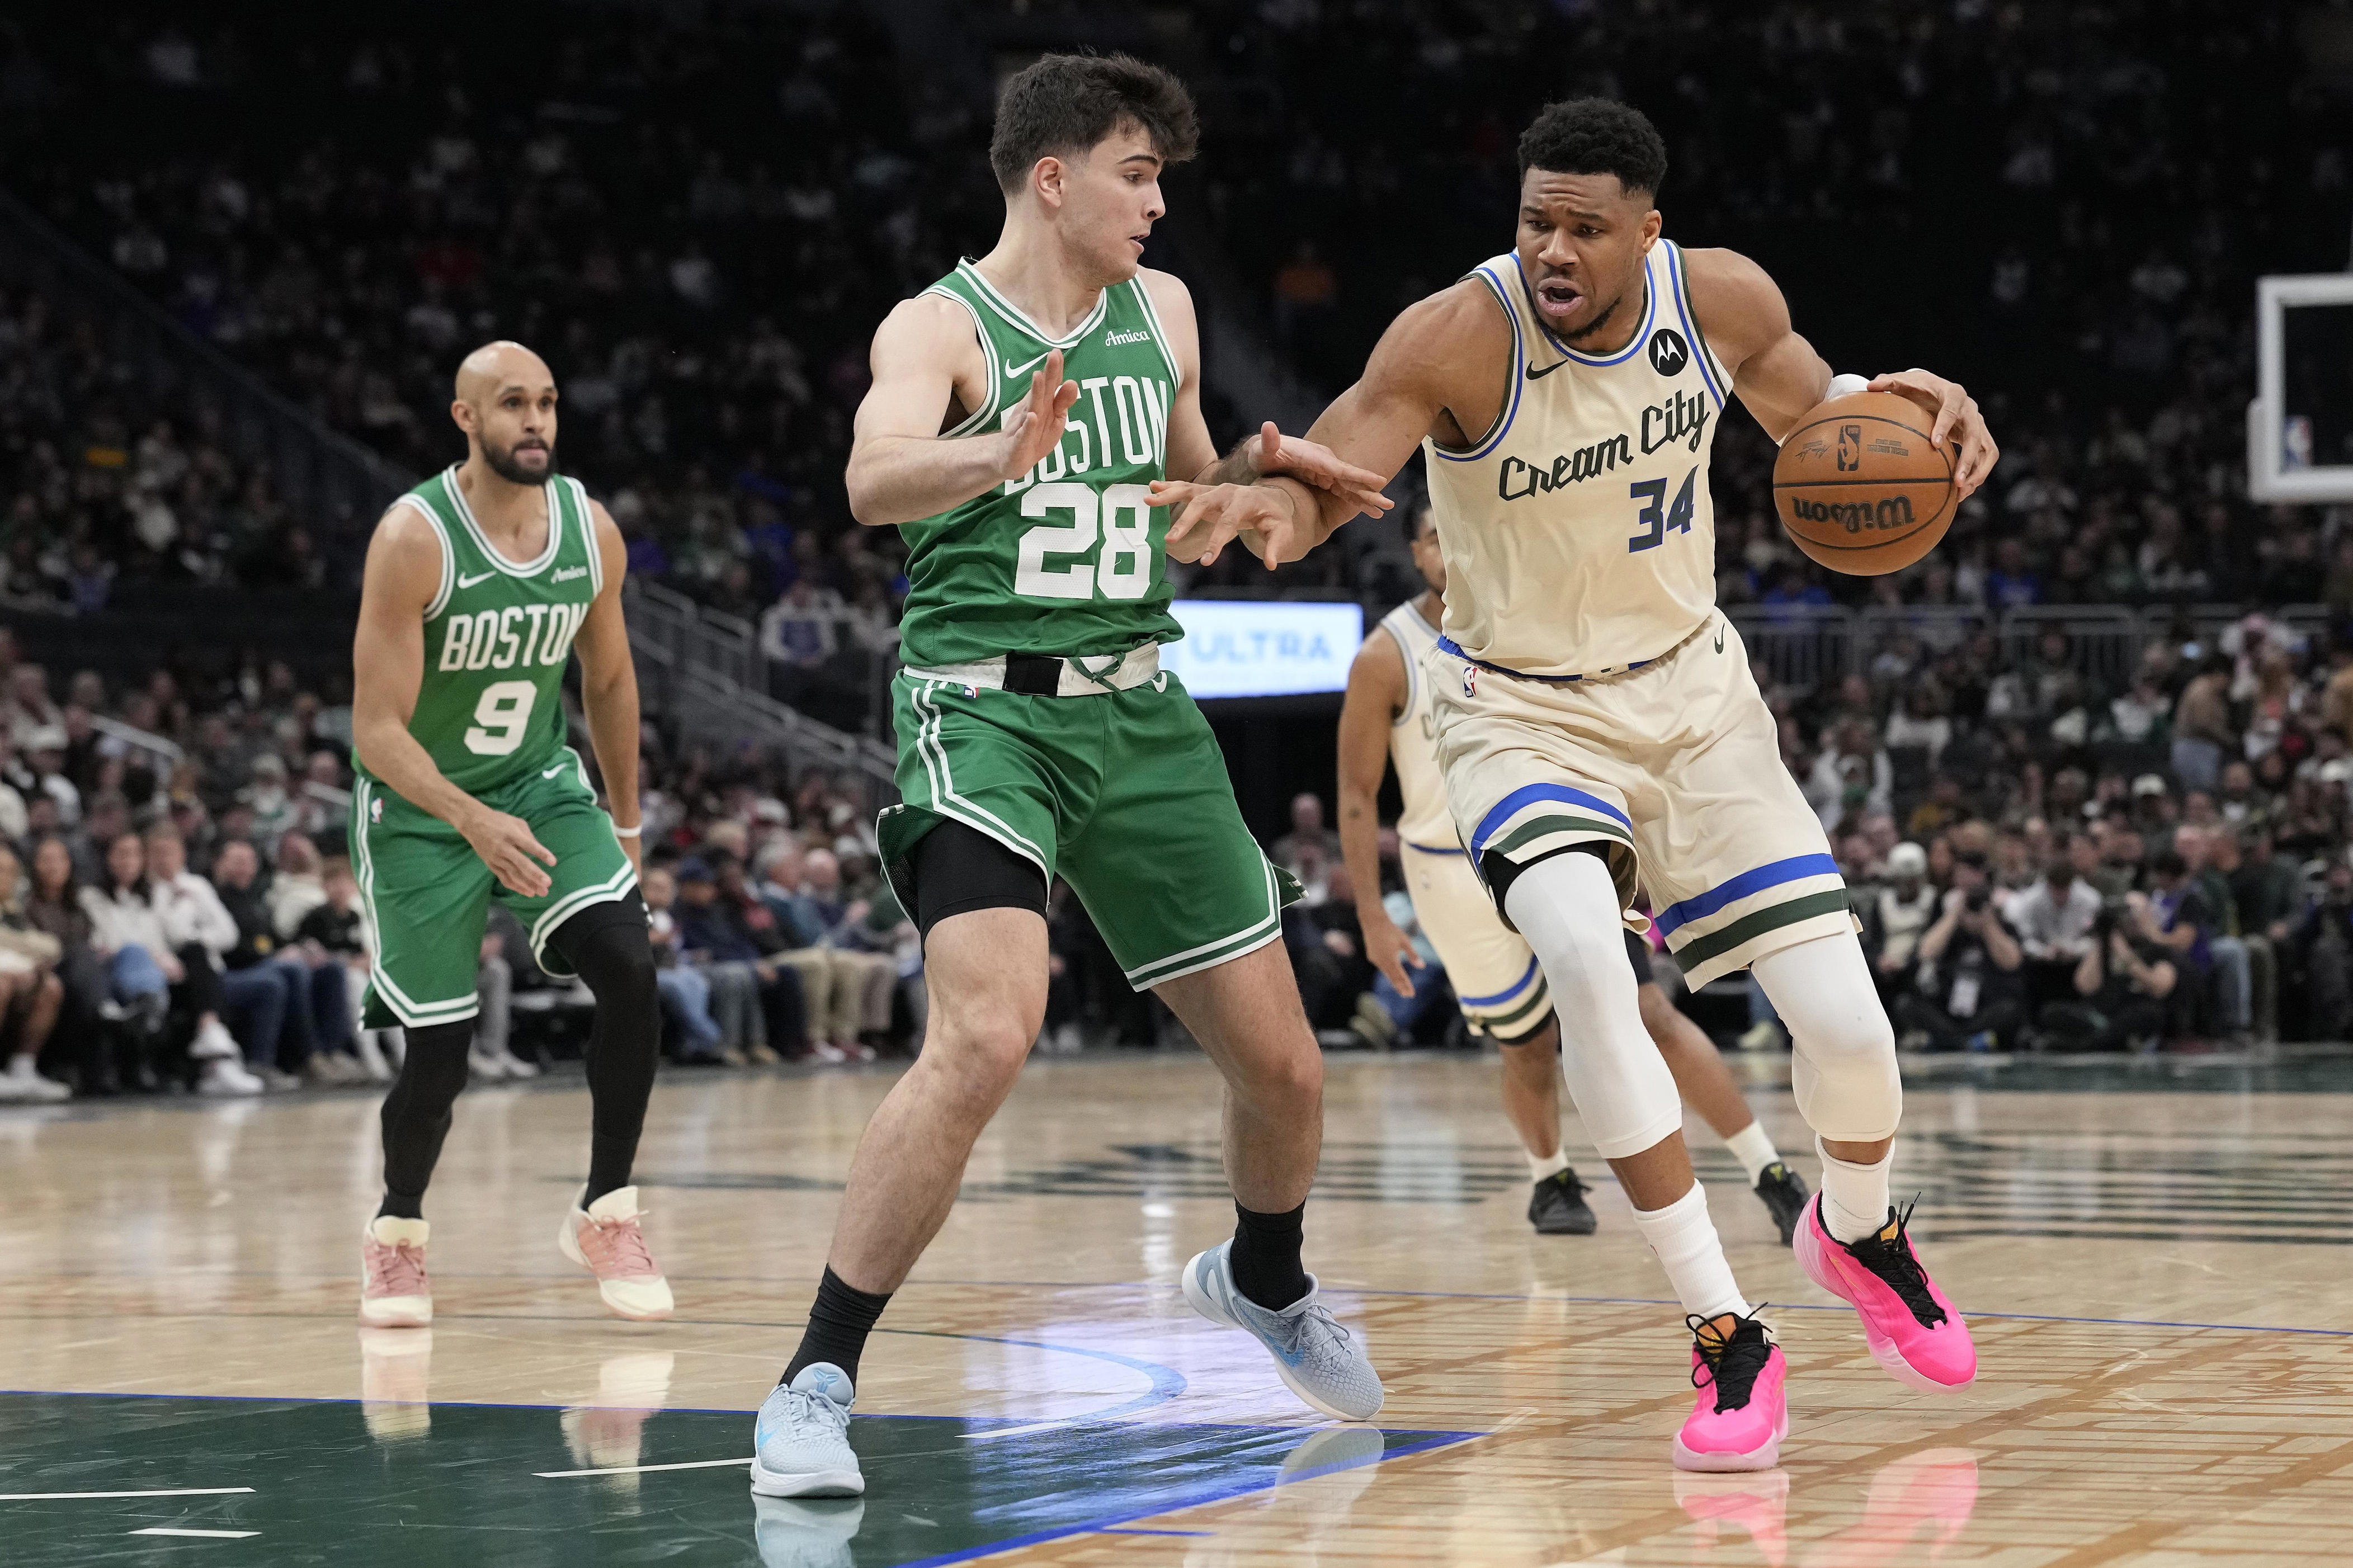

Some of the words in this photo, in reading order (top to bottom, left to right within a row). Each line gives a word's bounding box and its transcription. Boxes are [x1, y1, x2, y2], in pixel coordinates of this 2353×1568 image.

[1105, 329, 1150, 347] Amica
[1001, 376, 1167, 496] STON
[1499, 433, 1634, 501] Cream
[1641, 389, 1710, 455] City
[1014, 483, 1152, 599] 28
[1629, 464, 1699, 553] 34
[1792, 495, 1916, 533] Wilson
[1190, 631, 1333, 662] ULTRA
[464, 679, 537, 755] 9
